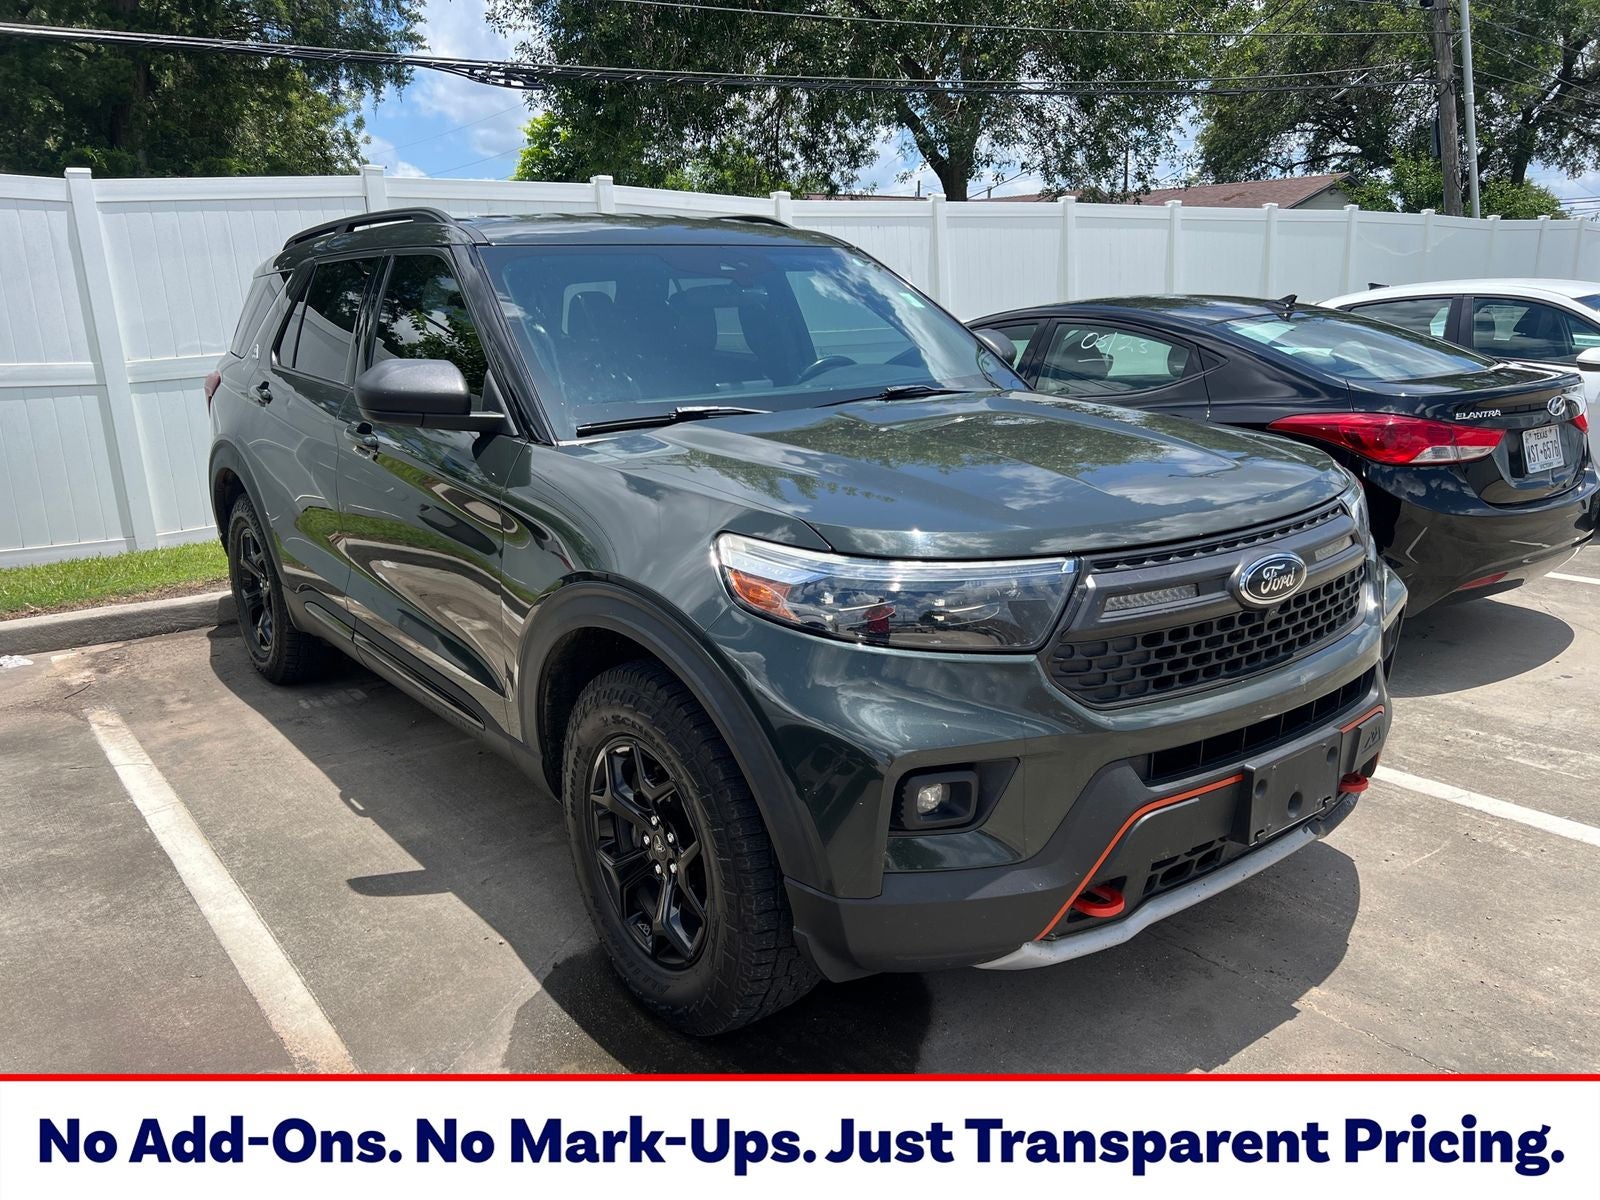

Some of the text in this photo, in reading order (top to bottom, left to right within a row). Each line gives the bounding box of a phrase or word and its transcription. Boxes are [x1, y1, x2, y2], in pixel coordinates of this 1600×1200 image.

[1455, 409, 1501, 420] ELANTRA
[1533, 430, 1548, 441] TEXAS
[1260, 564, 1295, 594] Ford
